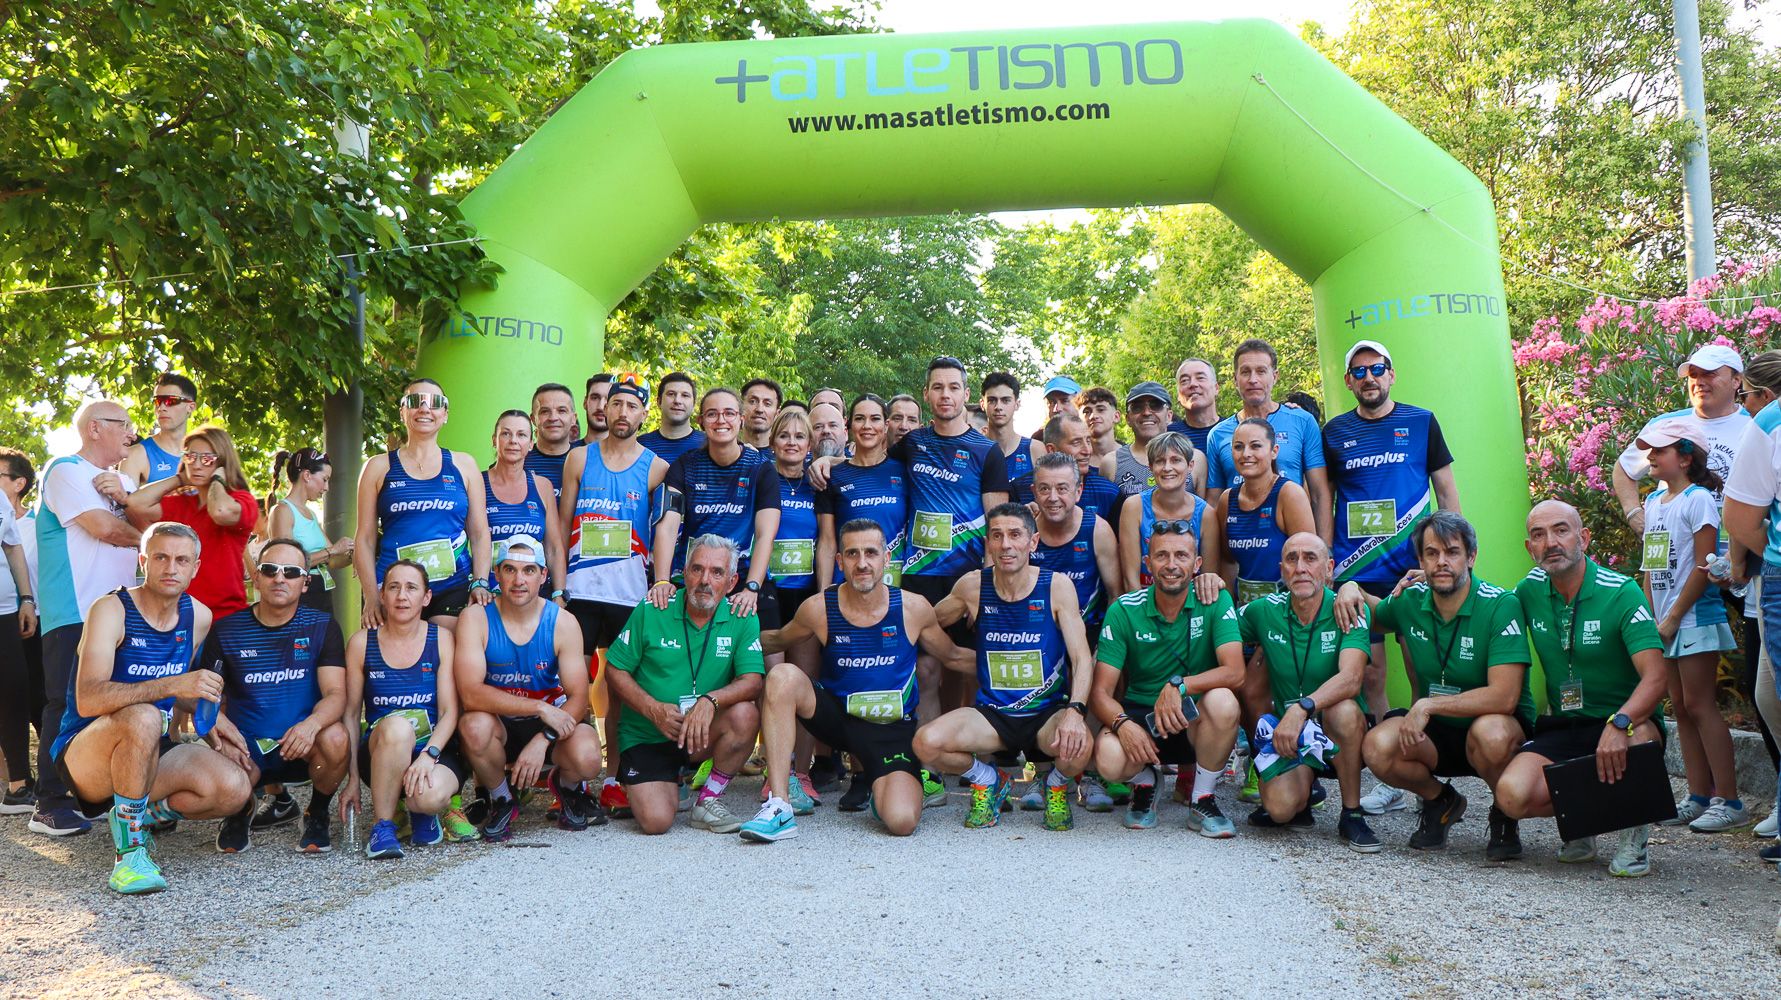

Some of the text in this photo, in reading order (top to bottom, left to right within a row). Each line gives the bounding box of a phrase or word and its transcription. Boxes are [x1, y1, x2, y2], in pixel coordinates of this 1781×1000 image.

[788, 102, 1110, 133] www.masatletismo.com
[1346, 452, 1405, 469] enerplus
[913, 464, 960, 482] enerplus
[390, 499, 454, 512] enerplus
[576, 498, 622, 511] nerplus
[781, 499, 814, 509] nerplu
[851, 496, 897, 507] enerplus
[695, 503, 744, 514] enerplus
[1361, 513, 1382, 527] 72
[920, 524, 938, 538] 96
[603, 533, 609, 546] 1
[781, 551, 802, 564] 62
[1647, 545, 1664, 558] 397
[986, 632, 1041, 644] enerplus
[837, 655, 895, 669] enerplus
[128, 662, 183, 678] enerplus
[245, 668, 305, 684] enerplus
[1000, 664, 1033, 678] 113
[488, 671, 531, 684] erplus
[373, 693, 432, 707] enerplus
[860, 704, 893, 717] 142
